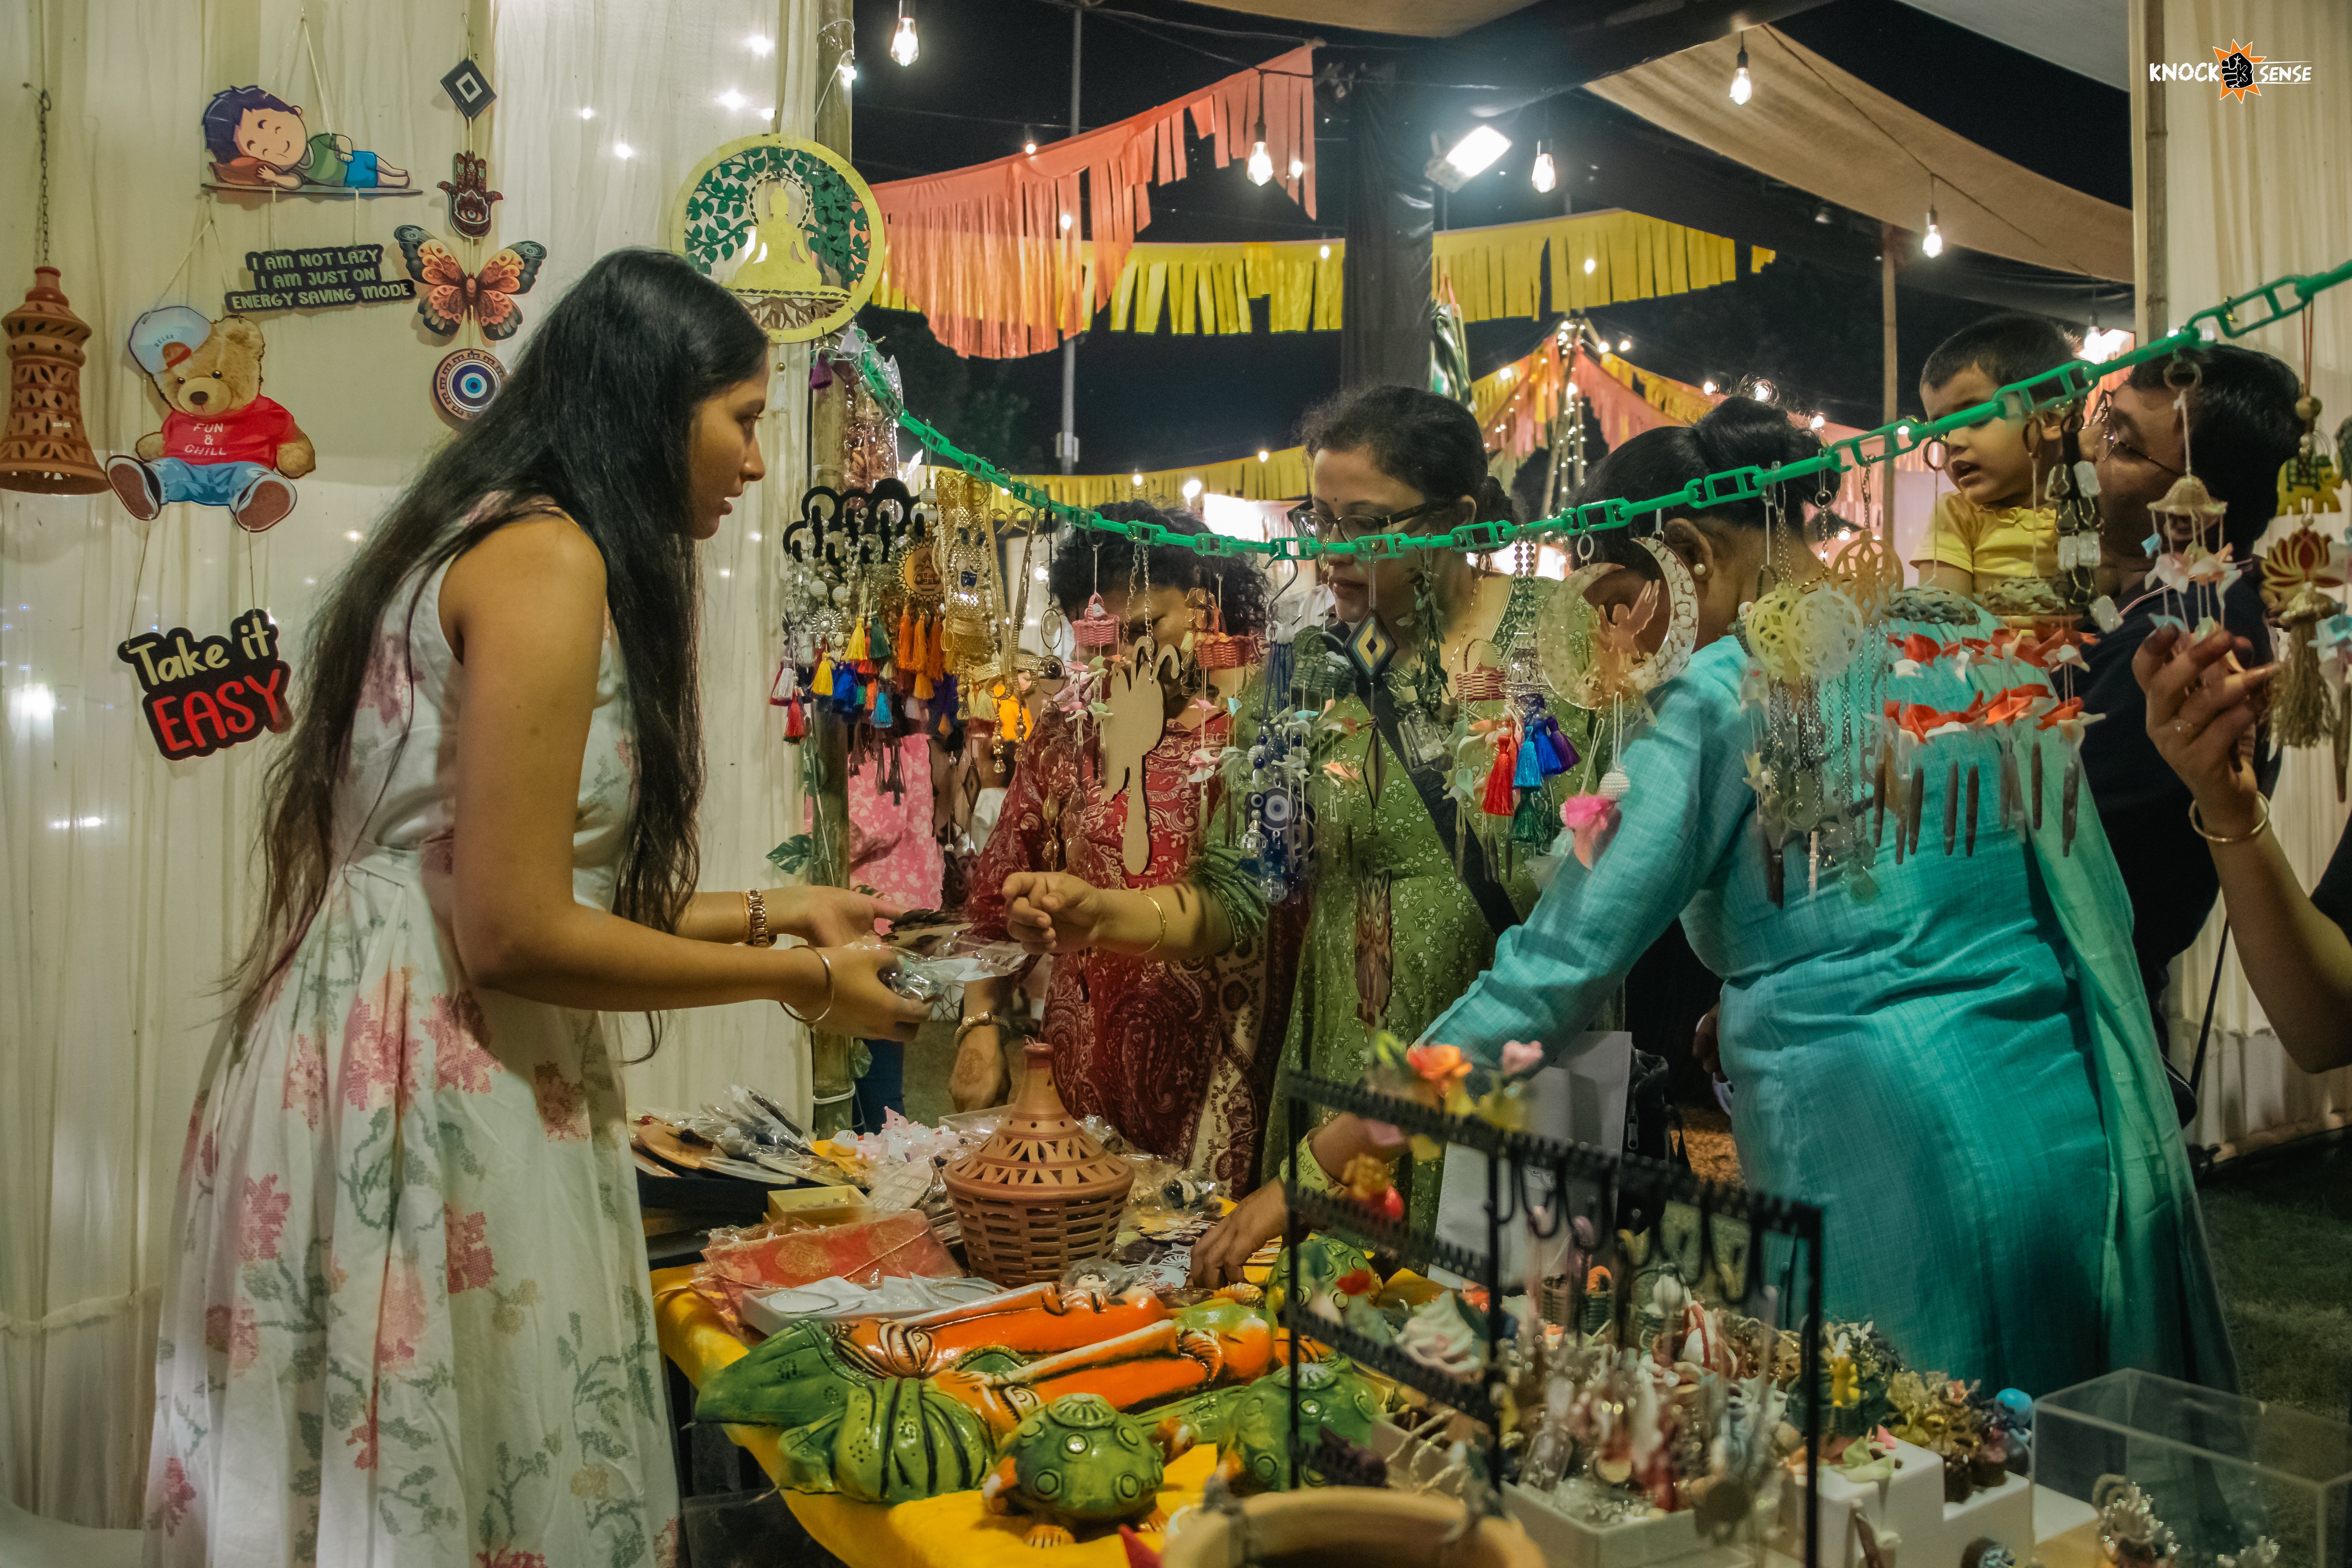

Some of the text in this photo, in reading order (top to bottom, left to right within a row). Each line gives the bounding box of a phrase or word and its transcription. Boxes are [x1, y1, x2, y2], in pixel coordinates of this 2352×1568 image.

[252, 249, 379, 270] I AM NOT LAZY
[260, 268, 376, 289] I AM JUST ON
[231, 283, 410, 310] ENERGY SAVING MODE
[192, 423, 224, 433] FUN
[184, 444, 227, 456] CHILL
[204, 434, 214, 445] &
[128, 617, 270, 686] Take it
[152, 668, 281, 751] EASY
